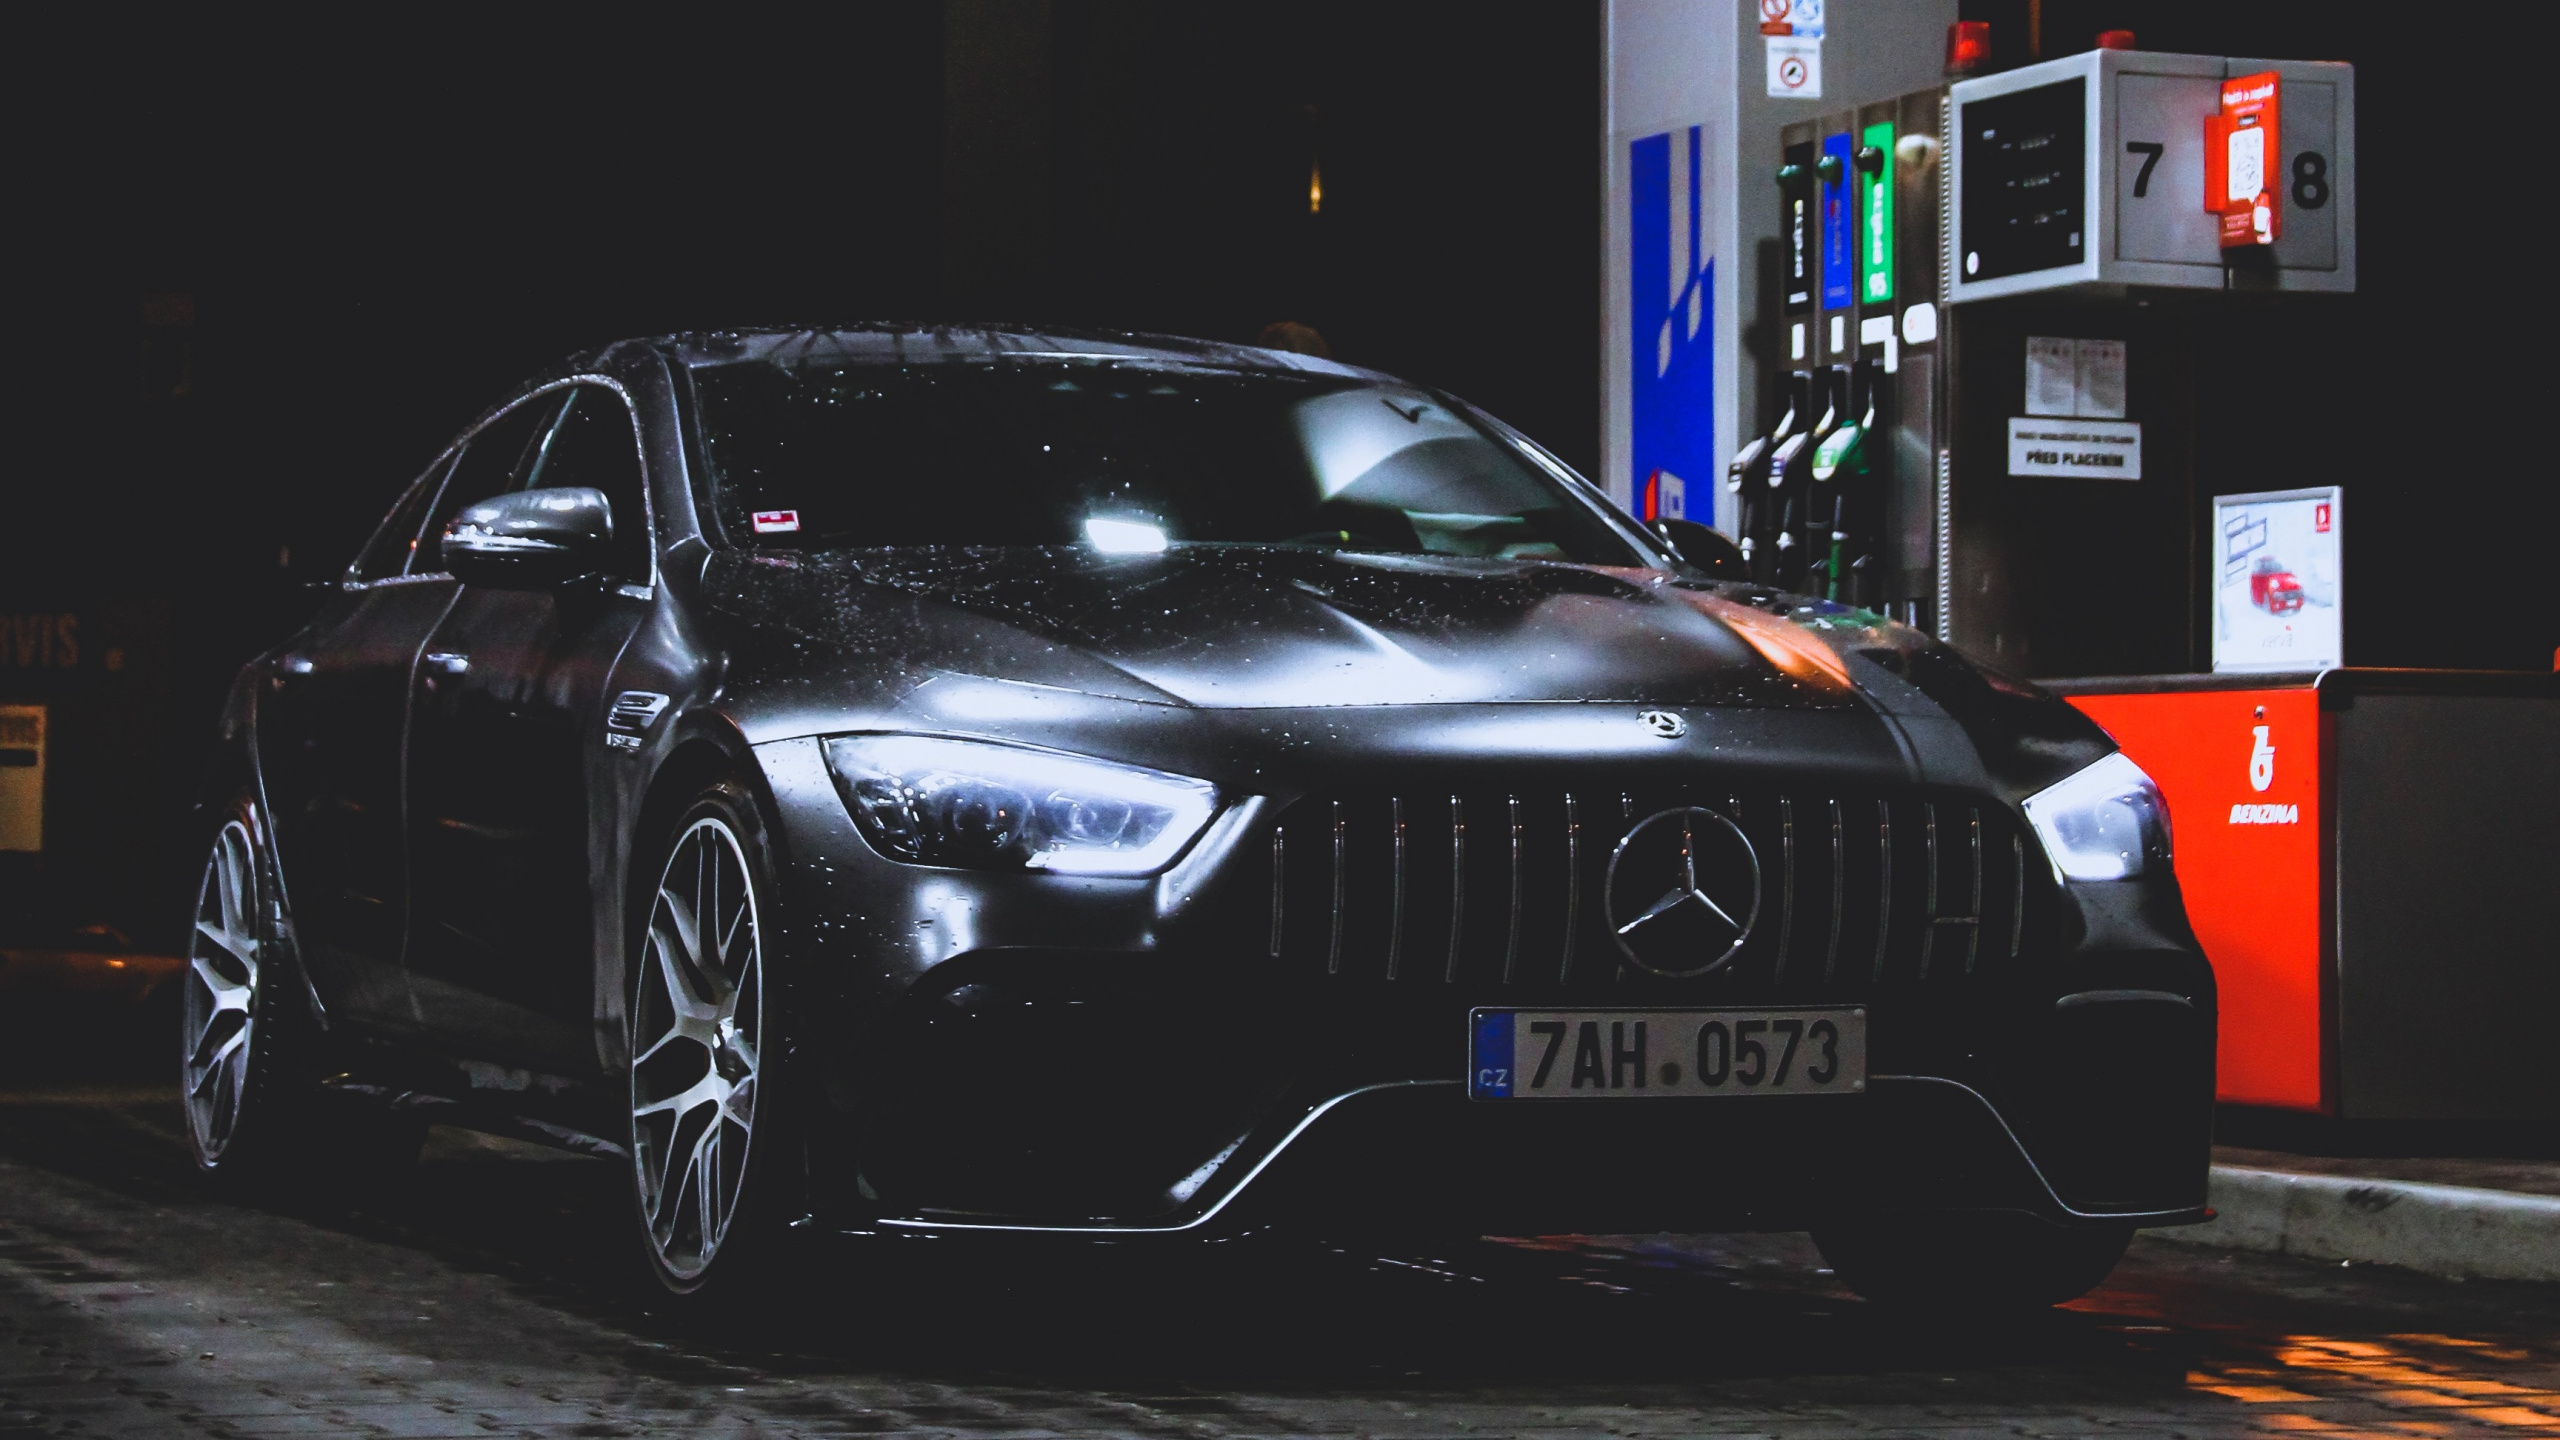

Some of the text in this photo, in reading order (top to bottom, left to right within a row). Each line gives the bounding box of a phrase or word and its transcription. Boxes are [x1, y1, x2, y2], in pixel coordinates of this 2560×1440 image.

[2126, 142, 2164, 198] 7
[2291, 151, 2330, 209] 8
[2229, 804, 2298, 824] BENZINA
[1478, 1068, 1508, 1087] CZ
[1530, 1019, 1839, 1088] 7AH 0573
